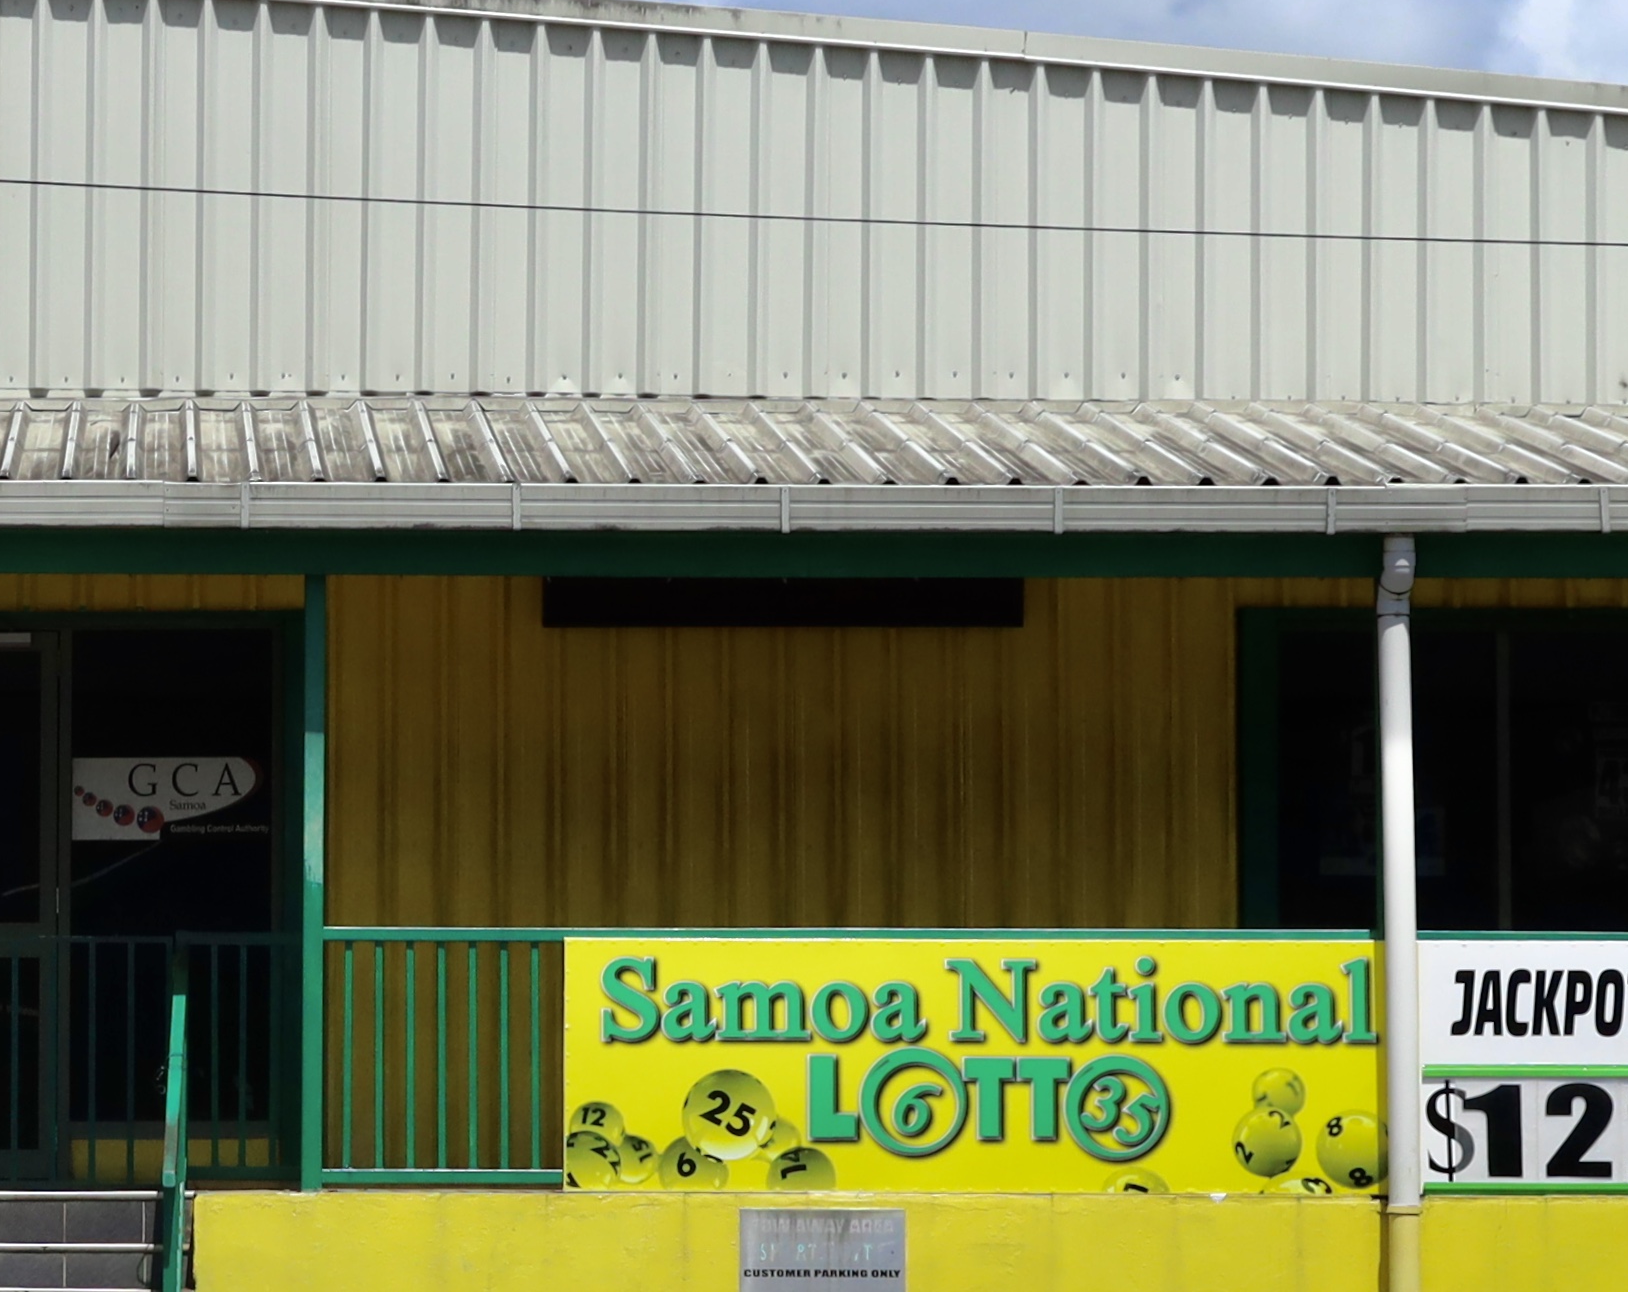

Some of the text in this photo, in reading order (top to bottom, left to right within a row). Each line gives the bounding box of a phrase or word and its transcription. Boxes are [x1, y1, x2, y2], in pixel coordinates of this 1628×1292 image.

[169, 800, 207, 811] Samoa
[169, 824, 269, 834] Gambling Control Authority
[600, 955, 1379, 1044] Samoa National
[699, 1090, 757, 1137] 25
[806, 1044, 1172, 1162] LOTTO
[581, 1108, 607, 1127] 12
[1326, 1116, 1343, 1137] 8
[677, 1152, 697, 1177] 6
[1349, 1167, 1374, 1188] 8
[848, 1218, 895, 1233] AREA
[743, 1268, 902, 1278] CUSTOMER PARKING ONLY
